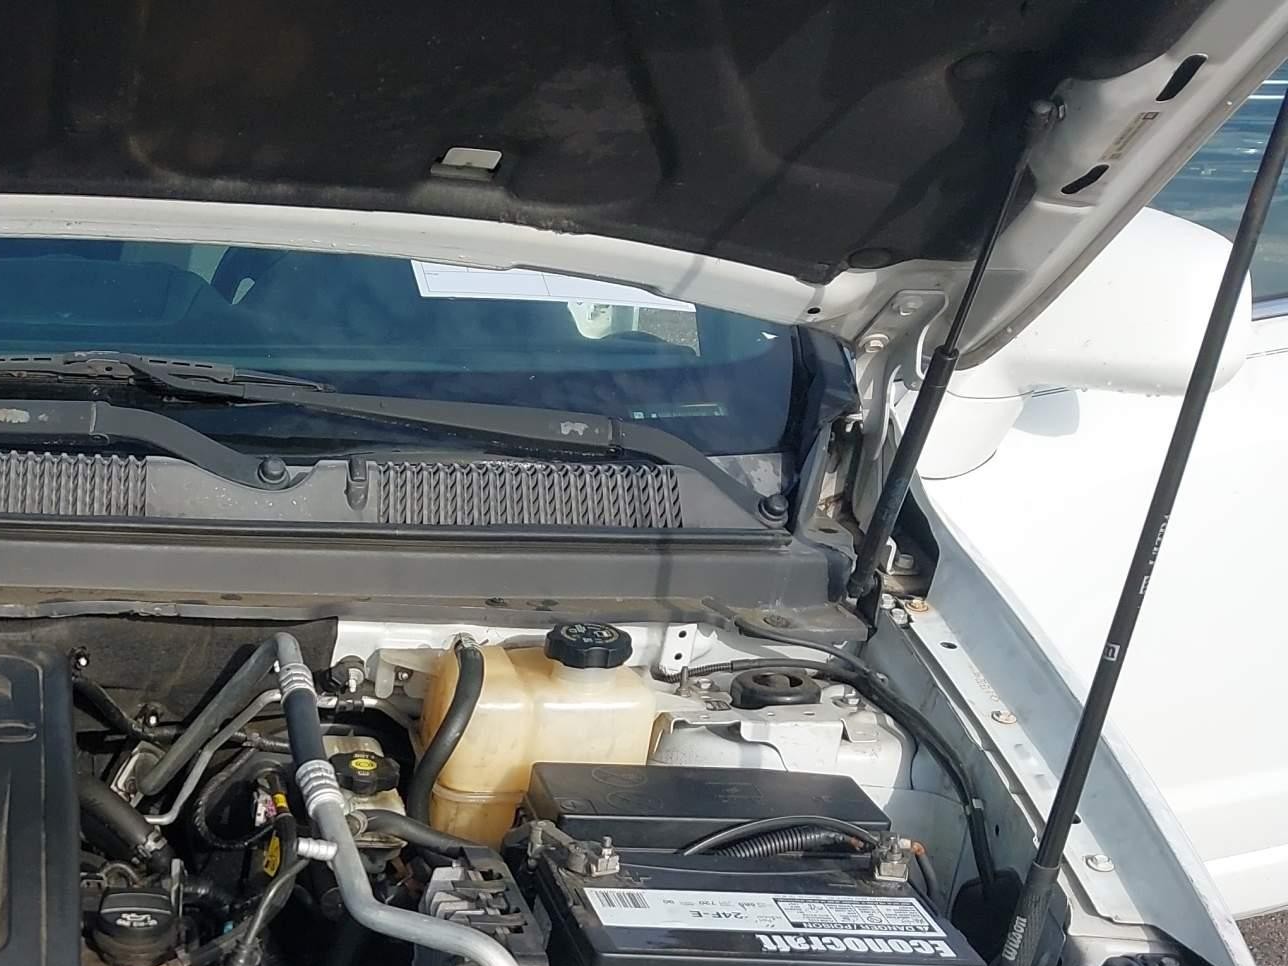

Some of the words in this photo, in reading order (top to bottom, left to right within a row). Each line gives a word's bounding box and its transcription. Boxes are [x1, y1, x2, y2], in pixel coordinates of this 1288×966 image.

[859, 924, 915, 932] DANGER
[1001, 915, 1028, 961] Wilson
[755, 934, 957, 958] Econocraft
